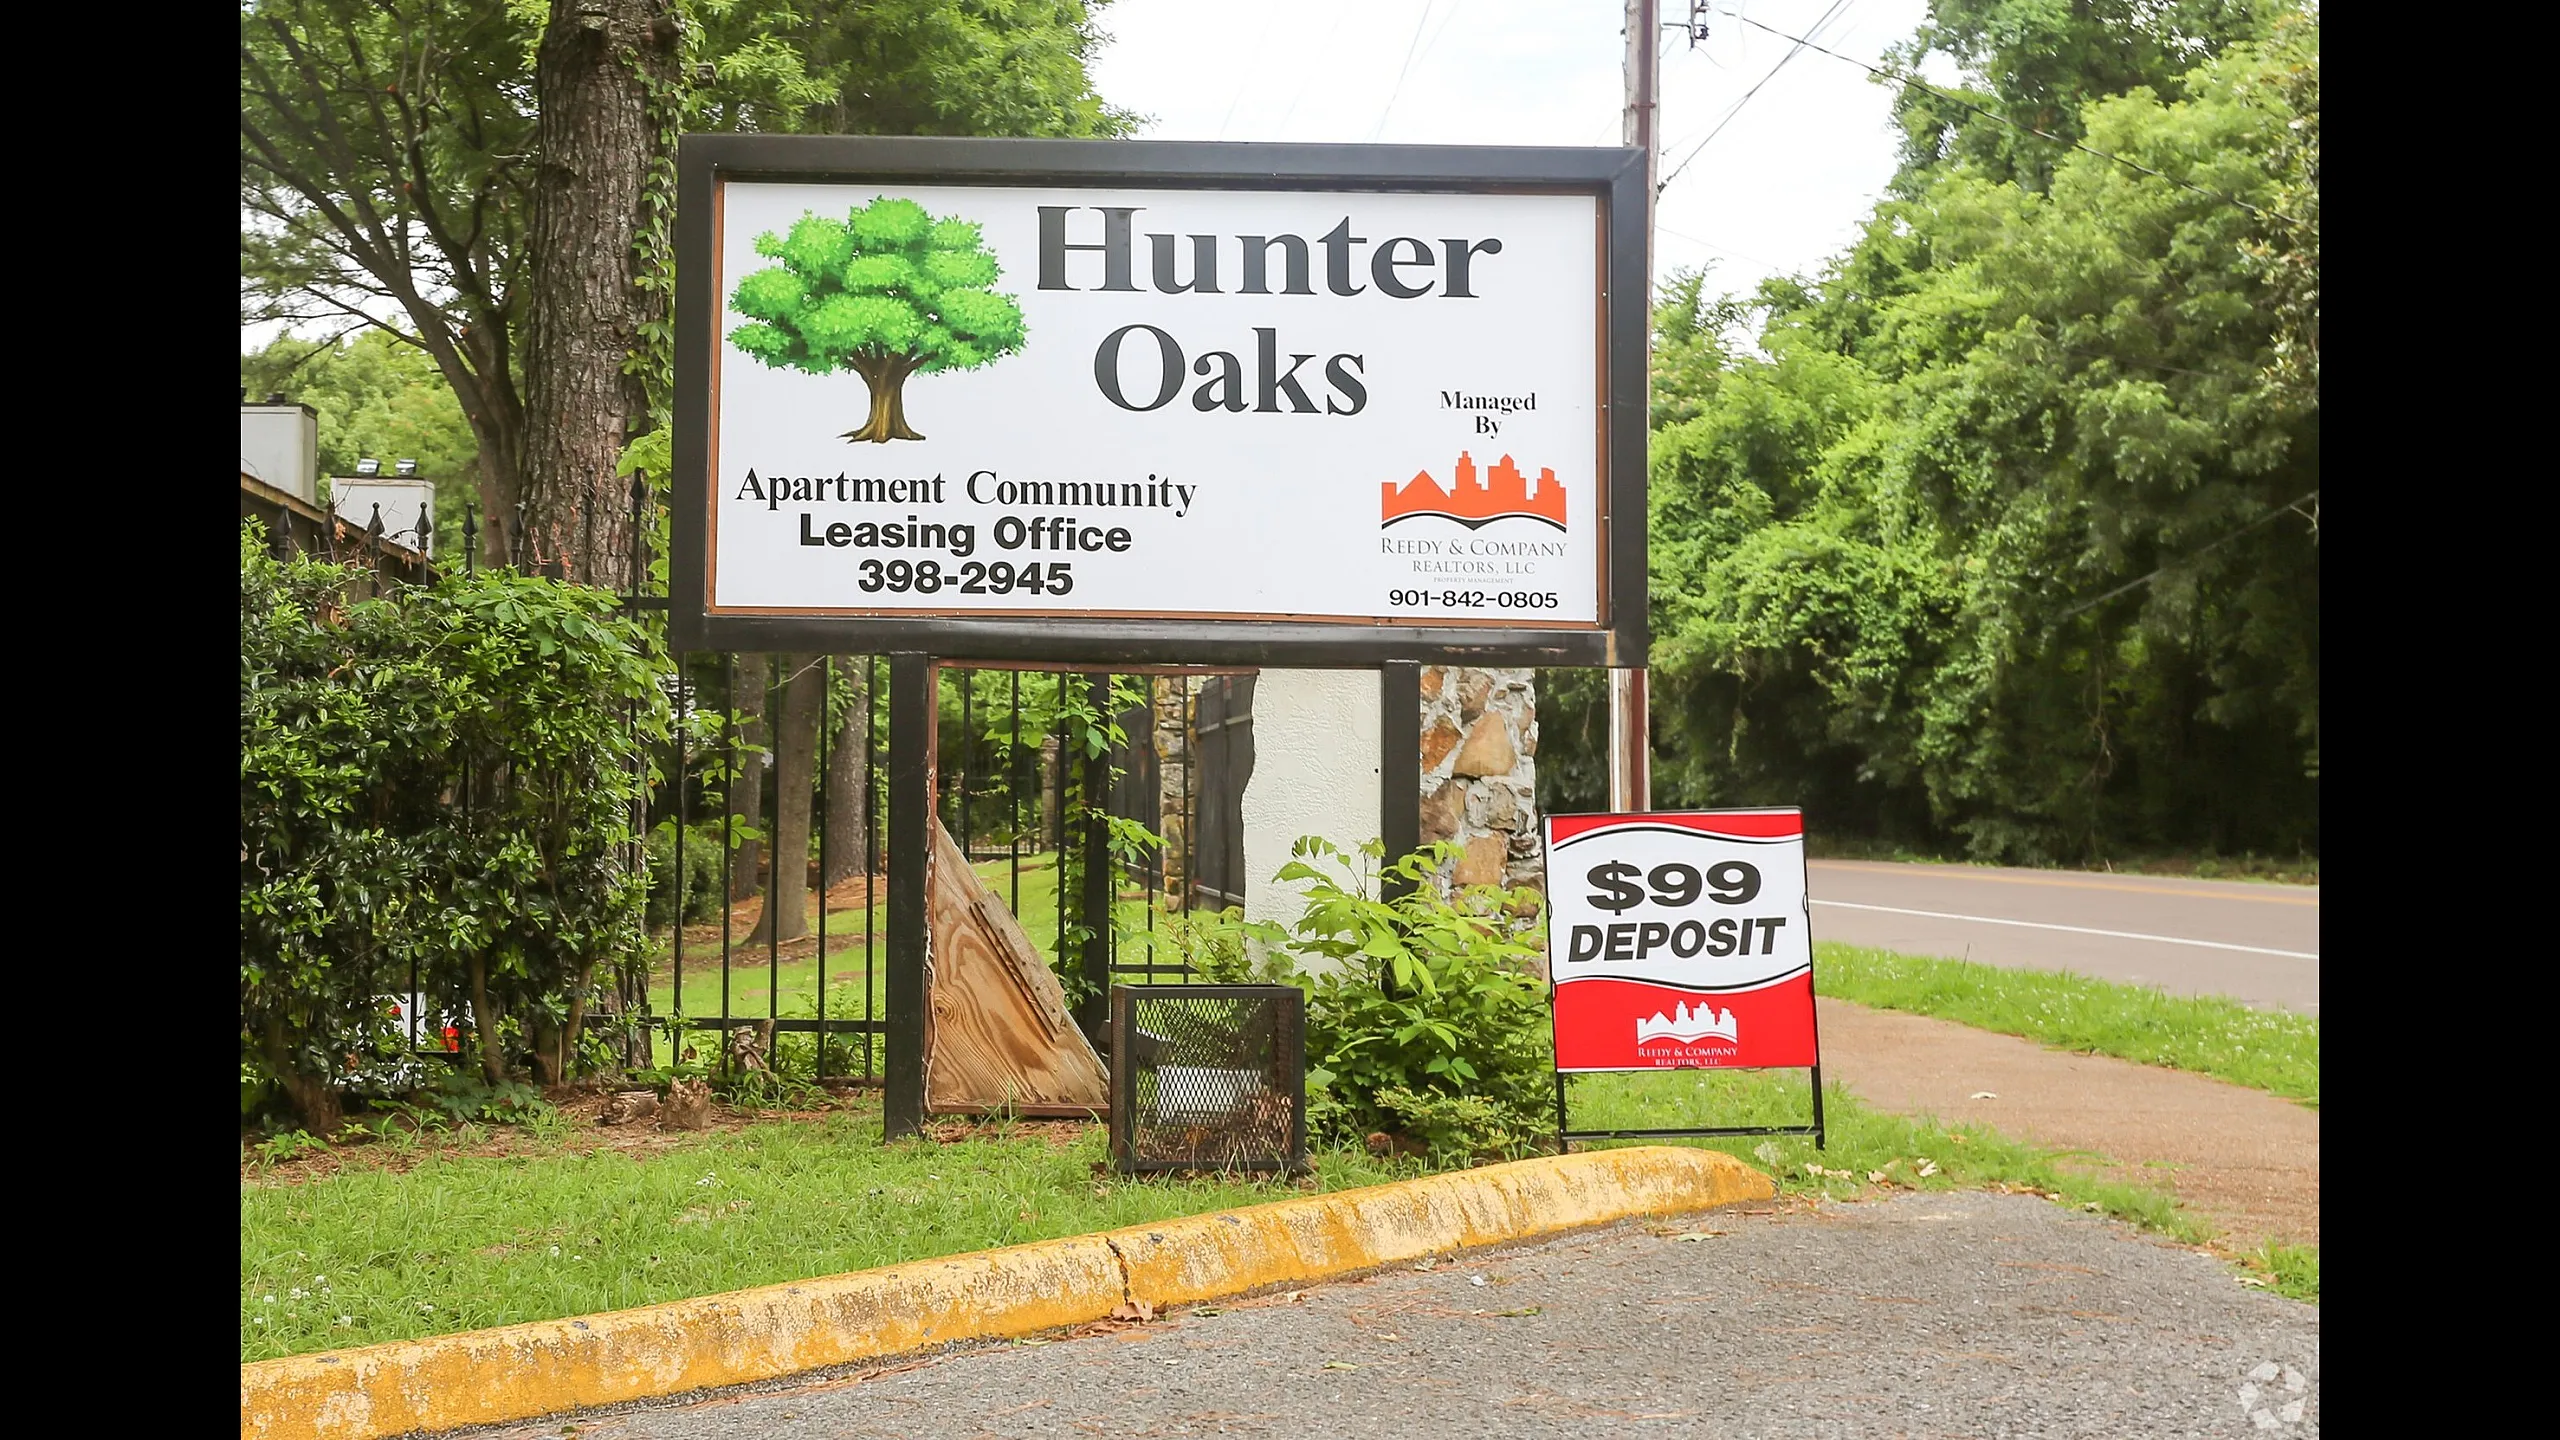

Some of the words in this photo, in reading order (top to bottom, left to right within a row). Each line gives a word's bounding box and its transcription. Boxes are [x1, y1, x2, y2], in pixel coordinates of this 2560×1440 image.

[1037, 206, 1502, 300] Hunter
[1094, 324, 1367, 416] Oaks
[1440, 391, 1536, 415] Managed
[1475, 415, 1502, 439] By
[736, 467, 946, 508] Apartment
[967, 470, 1197, 518] Community
[800, 514, 975, 556] Leasing
[994, 516, 1132, 552] Office
[1381, 538, 1443, 555] REEDY
[1448, 539, 1464, 555] &
[1470, 539, 1567, 557] COMPANY
[857, 559, 1074, 597] 398-2945
[1412, 560, 1499, 575] REALTORS,
[1506, 561, 1536, 575] LLC
[1433, 576, 1466, 584] PROPERTY
[1467, 576, 1514, 585] MANAGEMENT
[1389, 589, 1559, 609] 901-842-0805
[1586, 859, 1762, 916] $99
[1568, 917, 1787, 963] DEPOSIT
[1674, 1047, 1683, 1057] &
[1685, 1046, 1738, 1057] COMPANY
